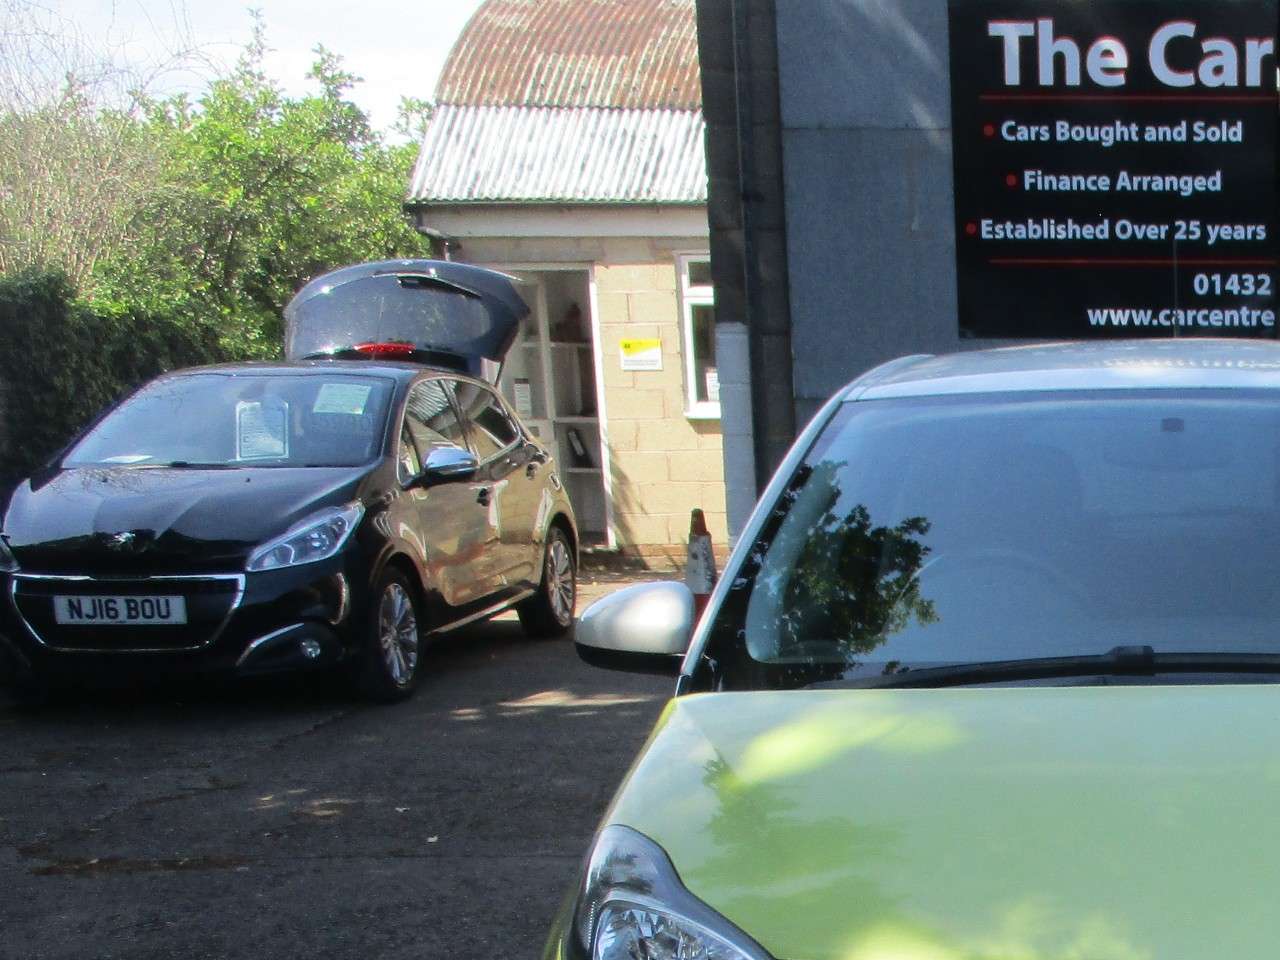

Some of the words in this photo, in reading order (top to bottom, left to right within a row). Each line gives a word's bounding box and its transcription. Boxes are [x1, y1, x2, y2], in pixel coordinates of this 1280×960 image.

[988, 18, 1129, 87] The
[1148, 21, 1274, 88] Car
[1001, 120, 1050, 141] Cars
[1055, 120, 1139, 147] Bought
[1144, 120, 1187, 142] and
[1193, 120, 1243, 142] Sold
[1024, 170, 1111, 191] Finance
[1116, 170, 1221, 196] Arranged
[981, 218, 1109, 240] Established
[1115, 219, 1169, 240] Over
[1174, 220, 1201, 240] 25
[1206, 224, 1266, 245] years
[1193, 273, 1271, 296] 01432
[68, 598, 119, 620] NJ16
[126, 598, 171, 619] BOU
